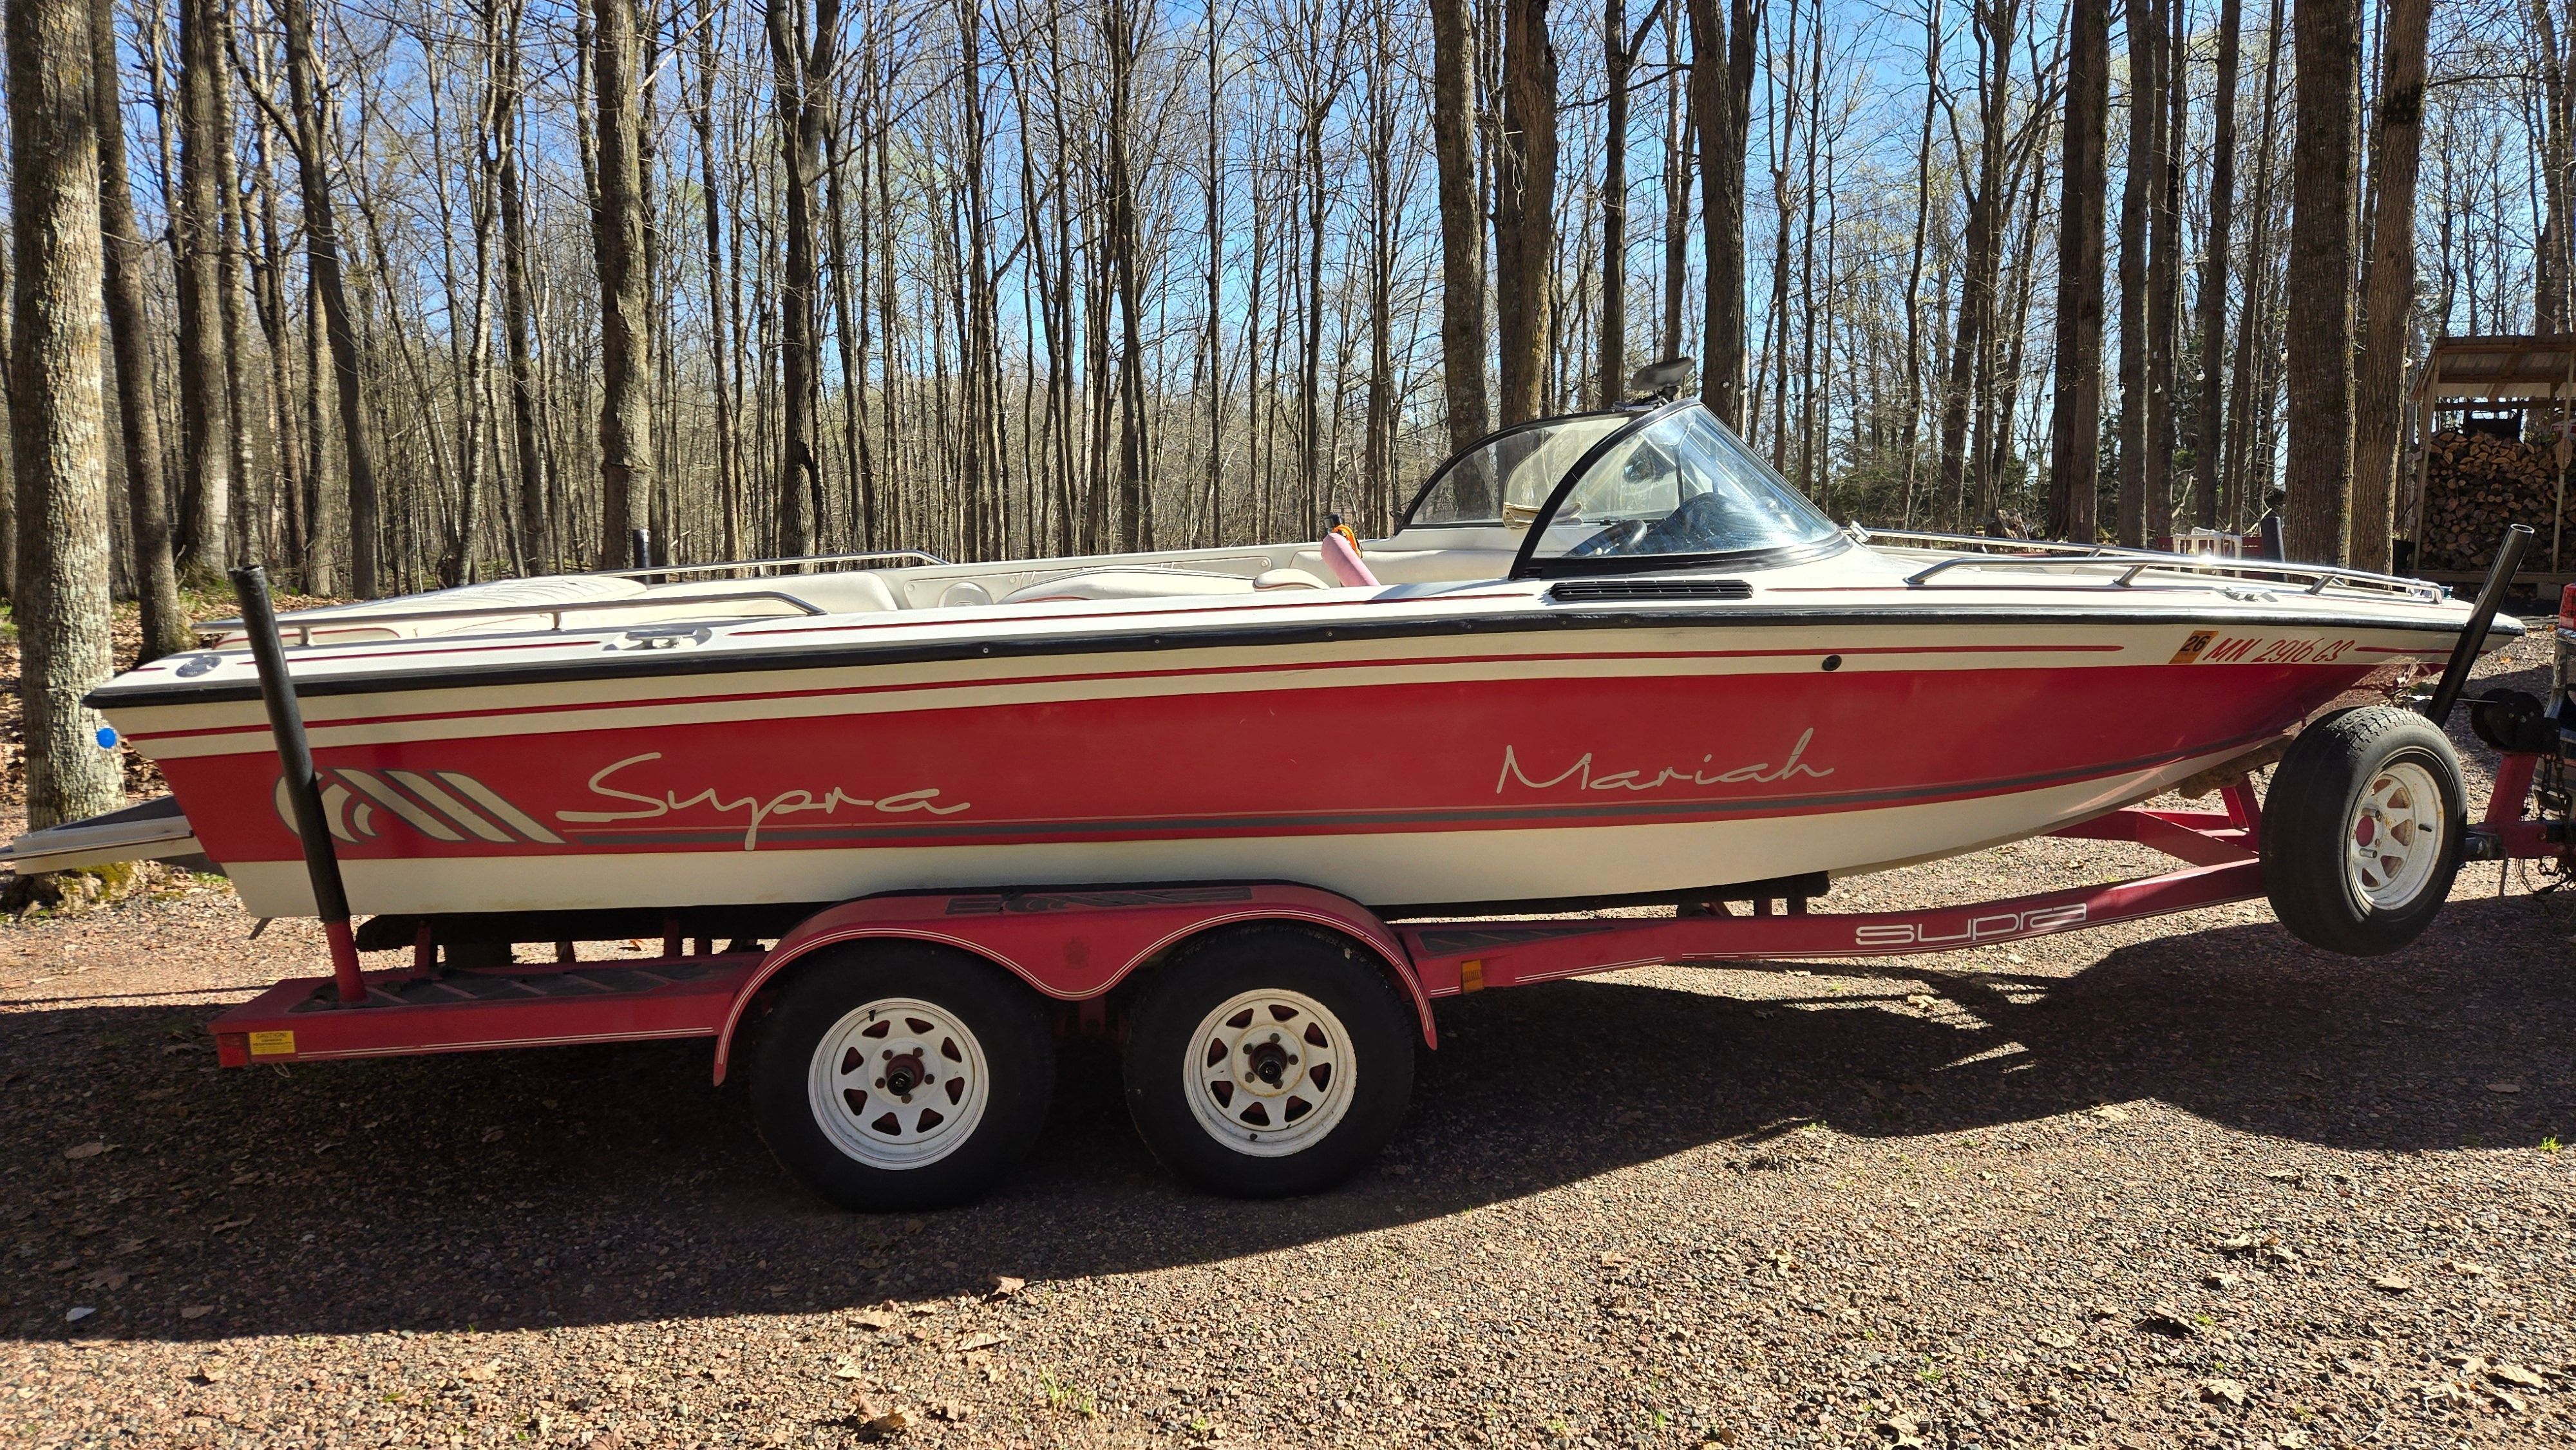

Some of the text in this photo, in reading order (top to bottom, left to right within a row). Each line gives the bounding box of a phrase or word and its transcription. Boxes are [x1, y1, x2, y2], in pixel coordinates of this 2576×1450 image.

[2179, 636, 2210, 652] 26
[2202, 637, 2263, 662] MN
[2250, 637, 2325, 663] 2916
[1497, 728, 1835, 793] Mariah
[556, 753, 970, 851] Supra
